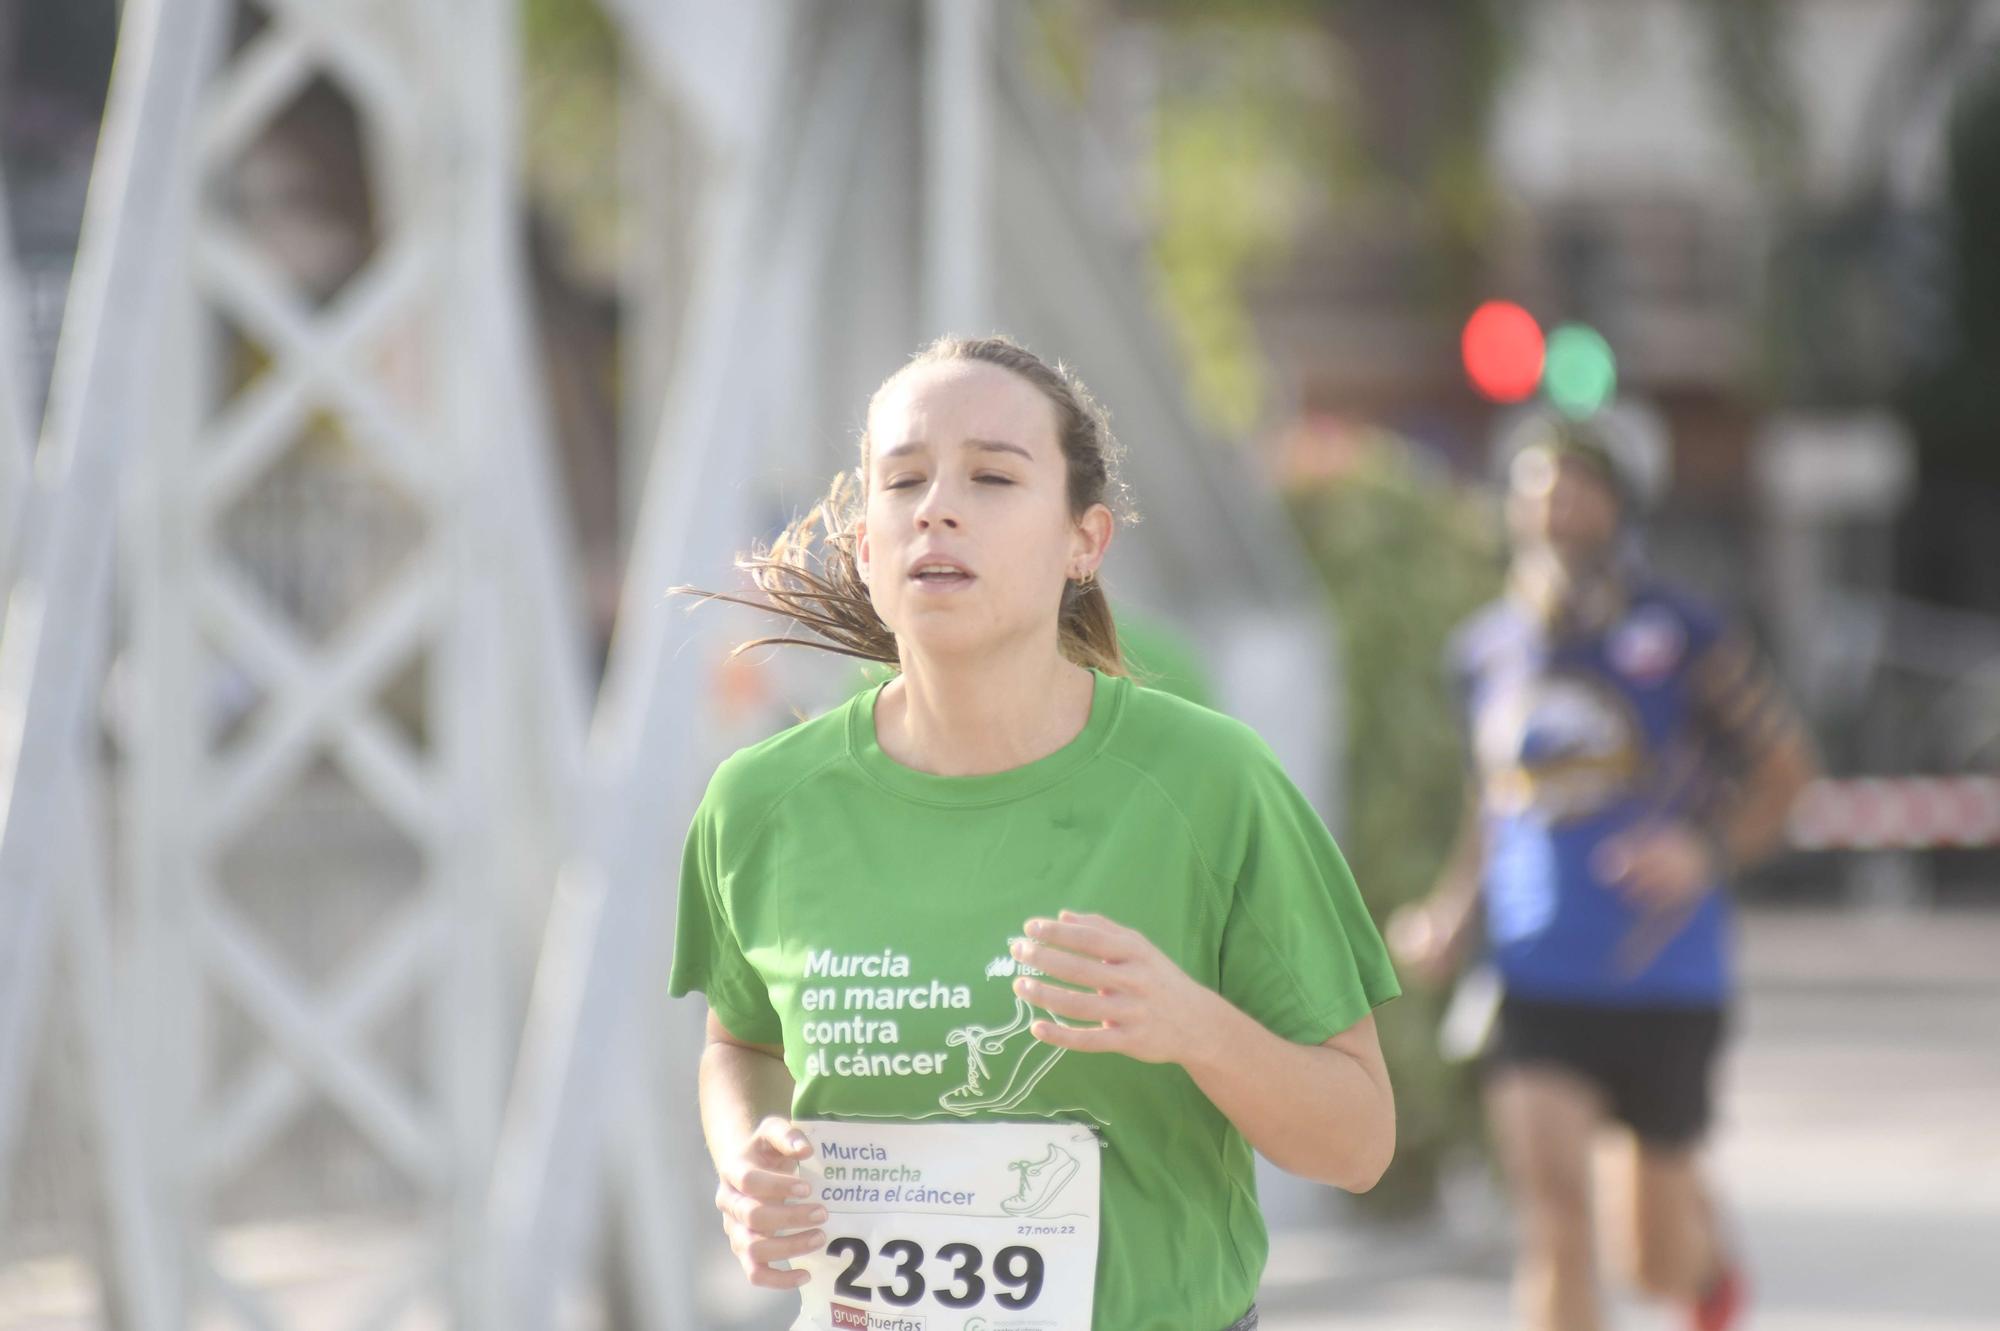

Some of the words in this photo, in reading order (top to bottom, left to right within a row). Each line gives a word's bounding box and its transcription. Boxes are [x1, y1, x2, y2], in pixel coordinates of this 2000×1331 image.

[803, 949, 910, 978] Murcia
[801, 987, 836, 1011] en
[843, 980, 971, 1010] marcha
[803, 1015, 899, 1044] contra
[806, 1048, 830, 1077] el
[834, 1048, 948, 1077] cáncer
[821, 1142, 887, 1161] Murcia
[823, 1165, 846, 1181] en
[851, 1164, 922, 1182] marcha
[821, 1185, 879, 1201] contra
[884, 1185, 900, 1202] el
[904, 1185, 975, 1205] cáncer
[1017, 1225, 1076, 1237] 27.nov.22
[825, 1237, 1045, 1311] 2339
